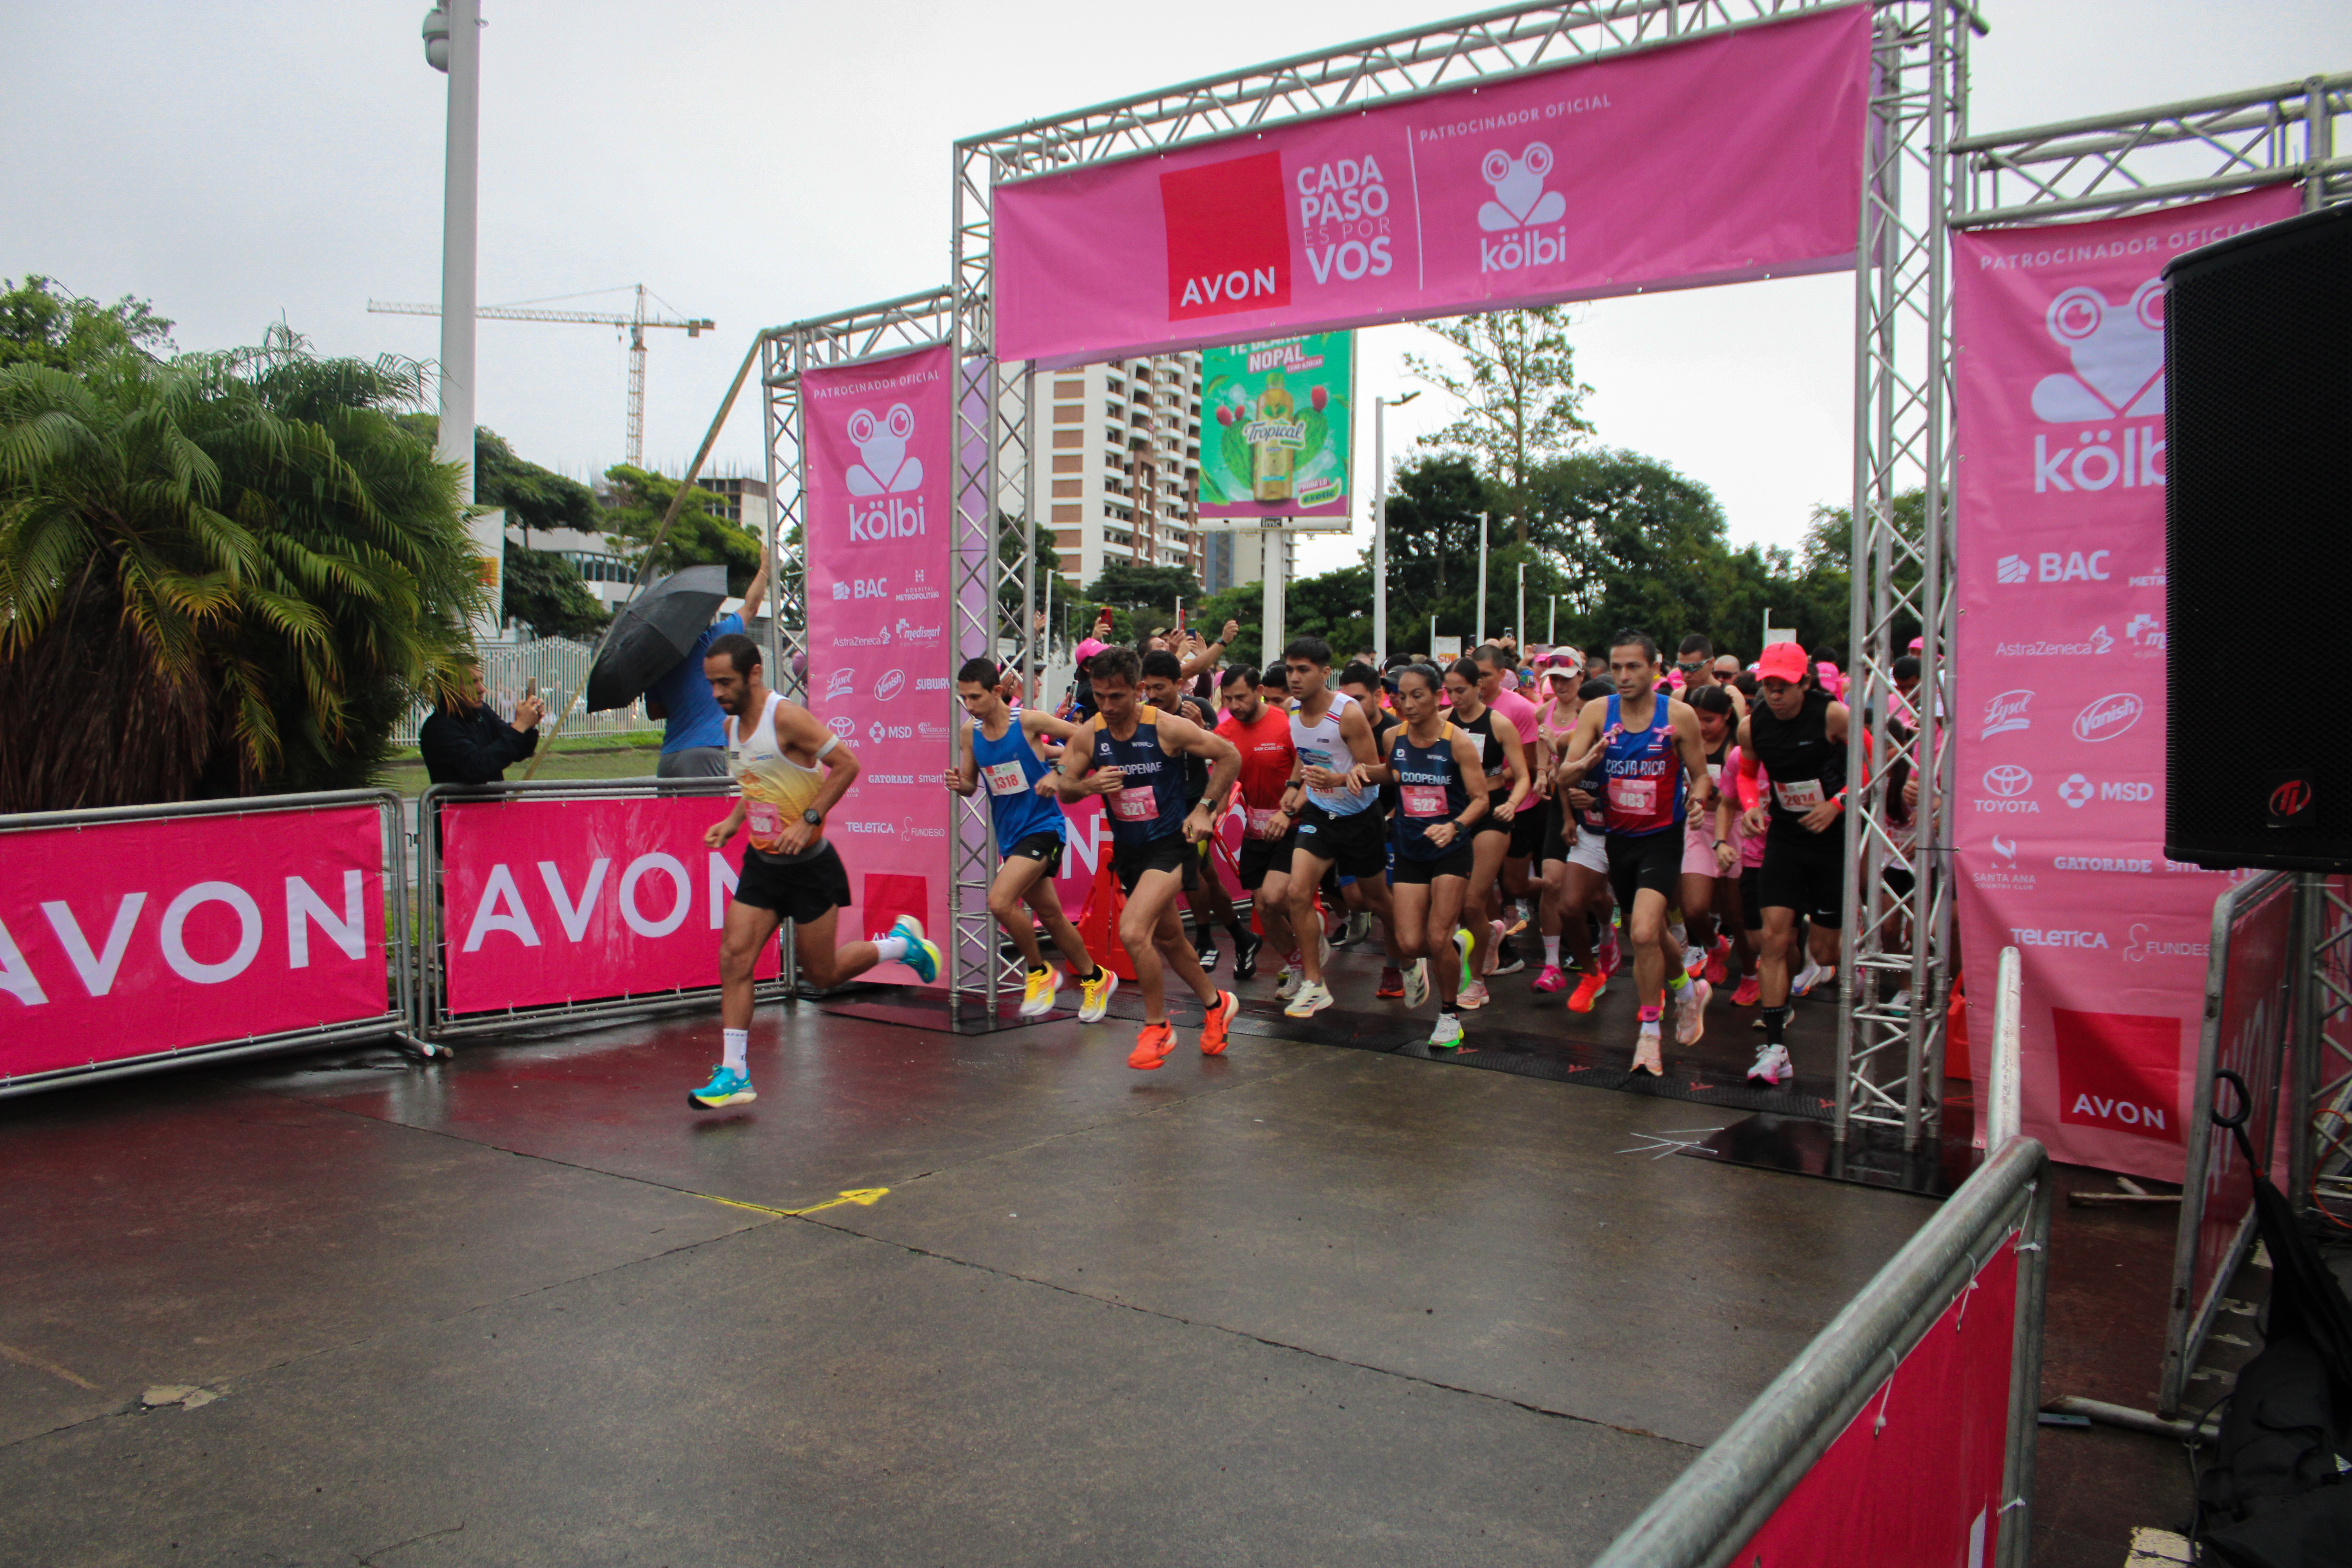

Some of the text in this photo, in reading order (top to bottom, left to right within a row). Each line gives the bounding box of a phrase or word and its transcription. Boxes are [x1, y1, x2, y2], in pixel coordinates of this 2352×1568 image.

[1420, 94, 1612, 142] PATROCINADOR OFICIAL
[1298, 155, 1384, 195] CADA
[1301, 184, 1389, 229] PASO
[1304, 217, 1391, 247] ES POR
[1481, 225, 1566, 273] kölbi
[1981, 239, 2158, 271] PATROCINADOR
[1306, 236, 1393, 284] VOS
[1181, 266, 1275, 307] AVON
[1249, 344, 1305, 372] NOPAL
[813, 370, 940, 399] PATROCINADOR OFICIAL
[1245, 421, 1305, 441] Tropical
[2035, 426, 2166, 493] kölb
[1304, 490, 1335, 503] exotic
[849, 495, 925, 541] kölbi
[2039, 550, 2111, 582] BAC
[854, 578, 888, 599] BAC
[896, 591, 940, 601] METROPOLITANO
[833, 637, 881, 647] AstraZeneca
[904, 626, 940, 641] medismart
[1996, 642, 2092, 656] AstraZeneca
[827, 671, 853, 691] Lysol
[878, 673, 902, 697] Vanish
[1984, 694, 2032, 724] Lysol
[2082, 698, 2136, 736] Vanish
[888, 726, 913, 738] MSD
[1118, 762, 1163, 775] OOPENAE
[1640, 760, 1666, 775] RICA
[868, 775, 914, 784] GATORADE
[993, 774, 1019, 789] 1318
[1401, 772, 1452, 785] COOPENAE
[1619, 793, 1645, 808] 483
[2101, 782, 2154, 801] MSD
[1121, 802, 1146, 816] 521
[1413, 799, 1437, 811] 522
[1974, 800, 2040, 813] TOYOTA
[911, 828, 945, 837] FUNDESO
[2054, 856, 2152, 873] GATORADE
[1973, 873, 2036, 883] SANTA ANA
[463, 851, 740, 953] AVON
[2146, 942, 2210, 956] FUNDES
[2072, 1093, 2165, 1130] AVON
